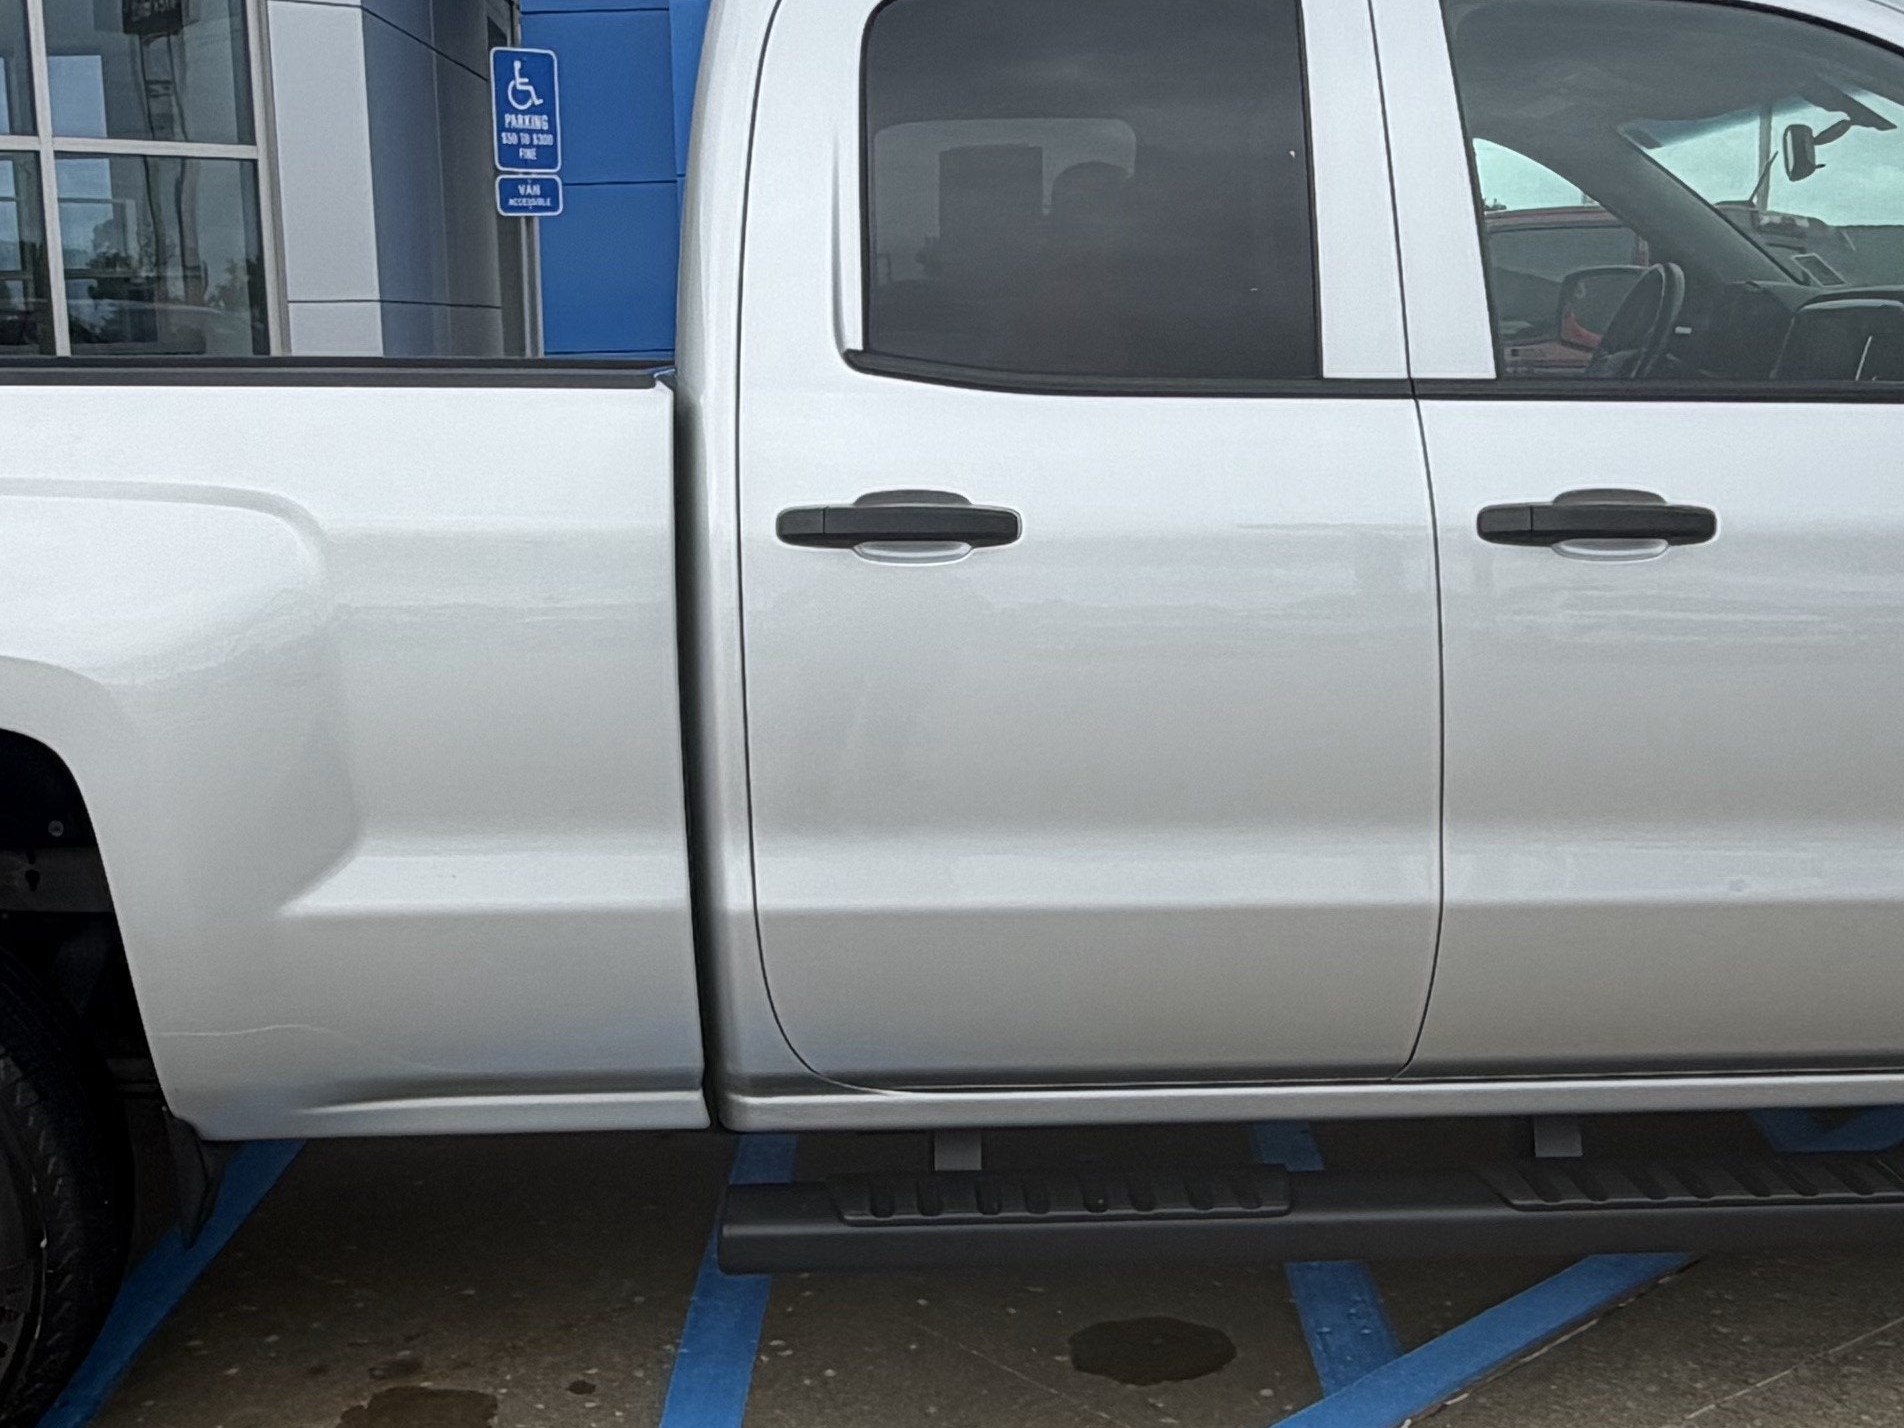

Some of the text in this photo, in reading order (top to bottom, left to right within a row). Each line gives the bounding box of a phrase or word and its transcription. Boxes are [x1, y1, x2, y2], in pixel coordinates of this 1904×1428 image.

[504, 113, 549, 131] PARKING
[519, 148, 537, 160] FINE
[518, 184, 541, 196] VAN
